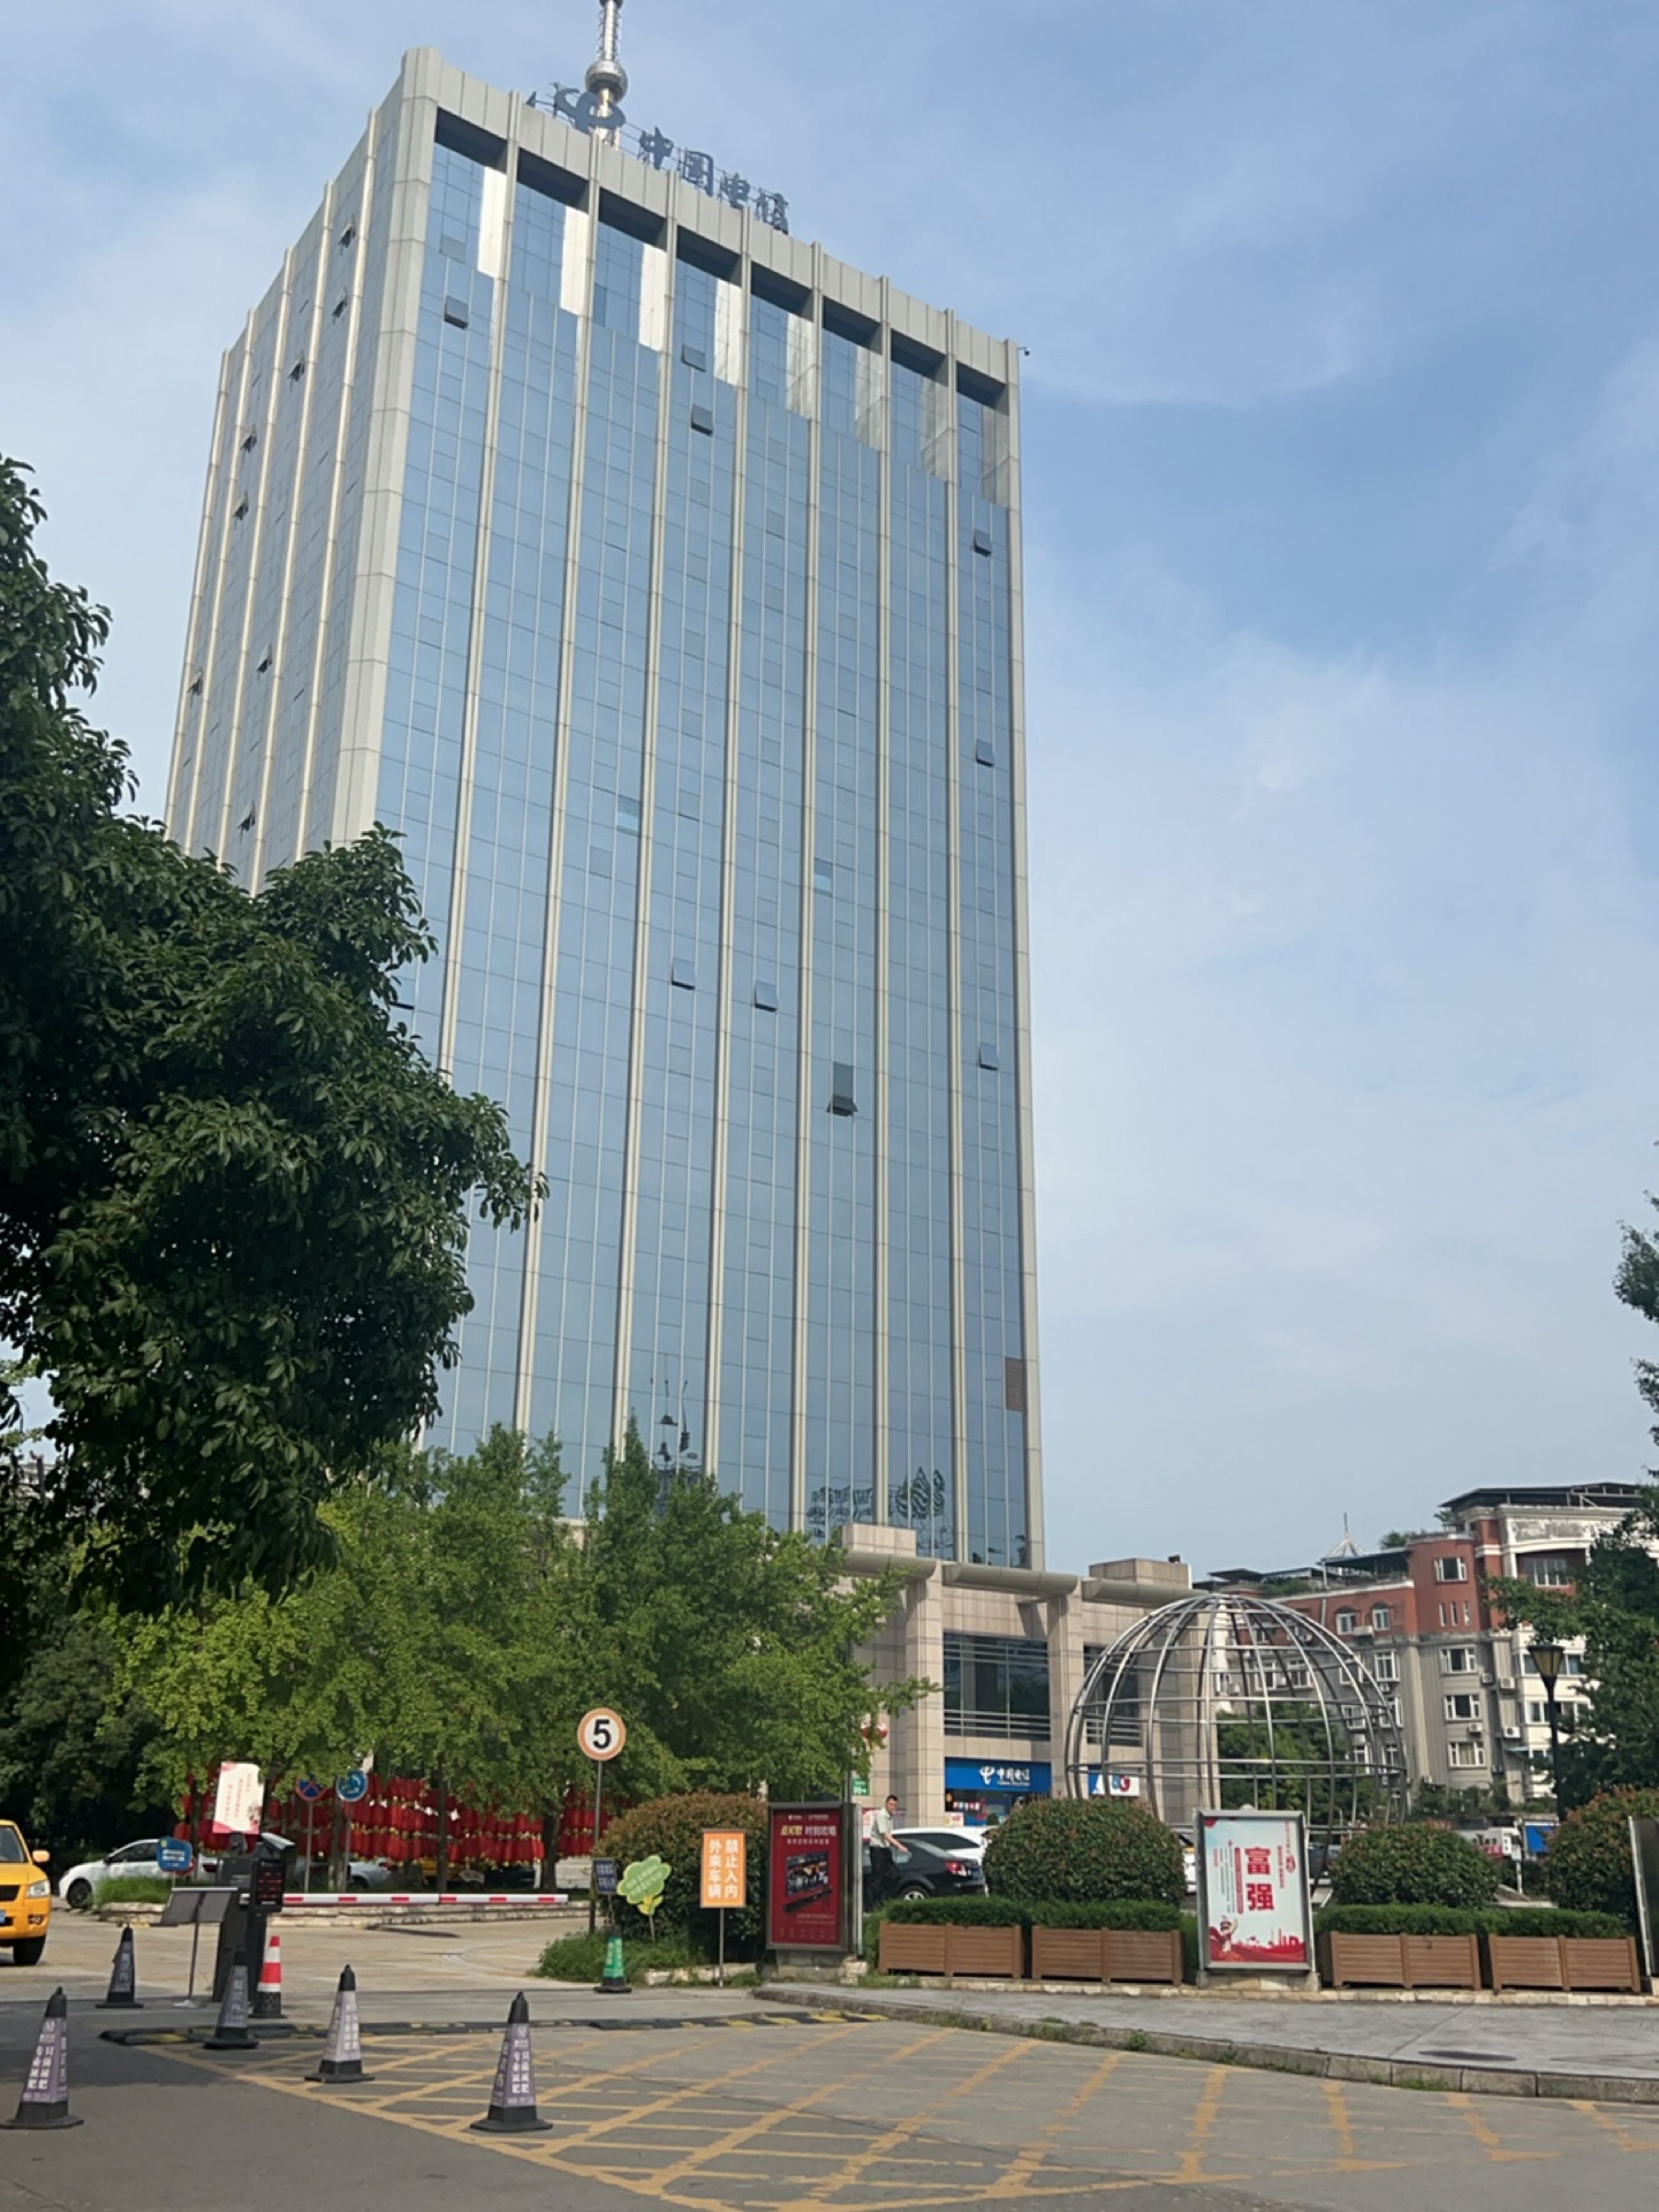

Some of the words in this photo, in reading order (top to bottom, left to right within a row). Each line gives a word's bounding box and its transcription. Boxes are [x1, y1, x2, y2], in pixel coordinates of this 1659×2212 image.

[639, 125, 789, 236] 中国电信
[593, 1719, 612, 1749] 5
[709, 1838, 722, 1898] 外来车辆
[725, 1838, 738, 1898] 禁止入内
[1245, 1847, 1274, 1911] 富强
